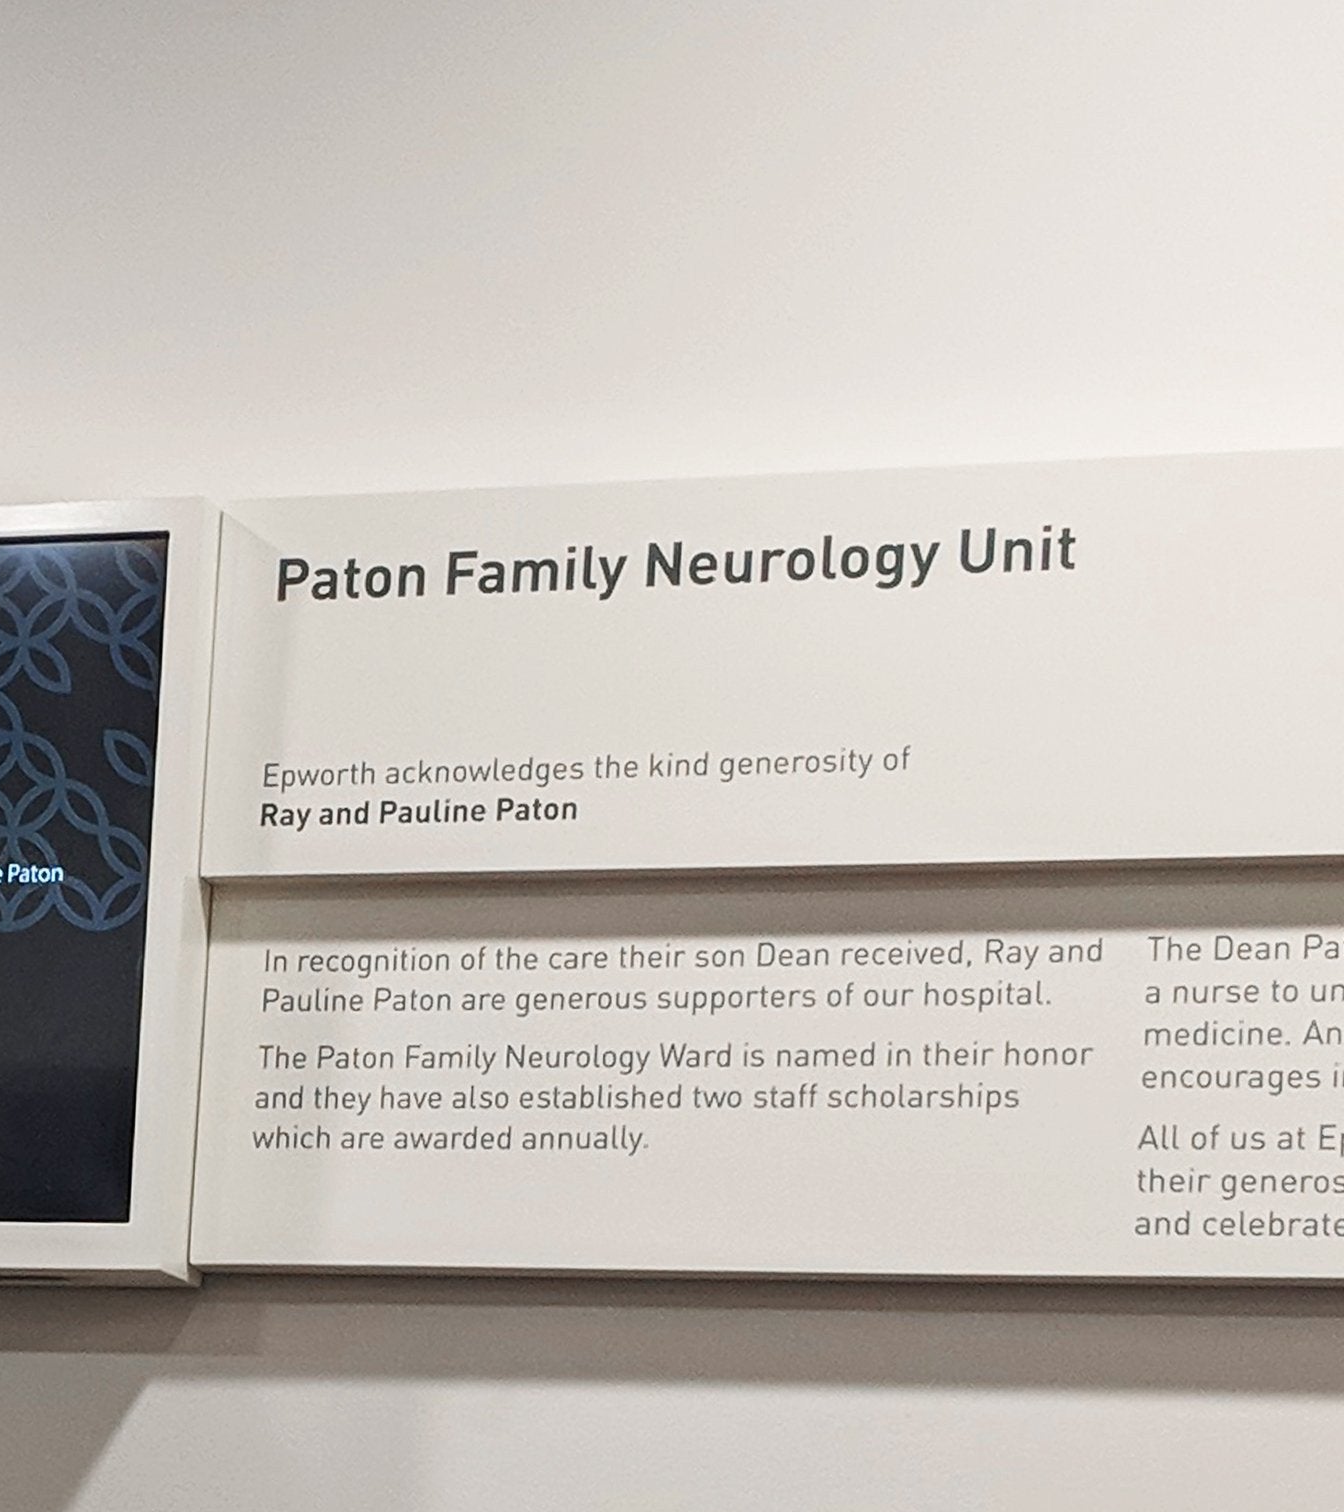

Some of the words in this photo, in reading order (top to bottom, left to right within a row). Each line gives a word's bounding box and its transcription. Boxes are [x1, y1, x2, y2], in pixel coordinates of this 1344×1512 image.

[277, 557, 426, 603] Paton
[446, 544, 628, 601] Family
[645, 534, 941, 590] Neurology
[960, 524, 1077, 574] Unit
[262, 760, 376, 795] Epworth
[385, 756, 585, 788] acknowledges
[594, 753, 639, 780] the
[649, 750, 710, 778] kind
[719, 747, 874, 783] generosity
[883, 744, 912, 772] of
[259, 802, 313, 833] Ray
[318, 800, 370, 826] and
[379, 798, 487, 825] Pauline
[496, 797, 578, 822] Paton
[7, 863, 64, 884] Paton
[264, 949, 288, 973] In
[297, 947, 450, 979] recognition
[460, 946, 486, 971] of
[495, 946, 539, 971] the
[548, 951, 608, 971] care
[619, 945, 686, 969] their
[694, 949, 745, 969] son
[756, 942, 830, 968] Dean
[841, 940, 972, 968] received,
[984, 938, 1040, 971] Ray
[1048, 937, 1103, 964] and
[1147, 936, 1202, 962] The
[1214, 935, 1290, 961] Dean
[262, 986, 364, 1013] Pauline
[373, 986, 452, 1012] Paton
[460, 992, 506, 1011] are
[515, 990, 648, 1018] generous
[657, 985, 817, 1016] supporters
[826, 981, 855, 1008] of
[863, 988, 915, 1008] our
[923, 979, 1052, 1013] hospital.
[1145, 985, 1161, 1005] a
[1172, 984, 1260, 1005] nurse
[1271, 979, 1299, 1003] to
[1144, 1019, 1291, 1047] medicine.
[258, 1044, 308, 1070] The
[316, 1044, 394, 1070] Paton
[405, 1043, 497, 1076] Family
[505, 1043, 651, 1076] Neurology
[659, 1042, 732, 1069] Ward
[743, 1041, 765, 1068] is
[776, 1041, 876, 1068] named
[887, 1041, 912, 1067] in
[923, 1040, 995, 1067] their
[1004, 1040, 1094, 1067] honor
[1141, 1069, 1322, 1097] encourages
[254, 1084, 304, 1110] and
[314, 1085, 372, 1117] they
[380, 1084, 443, 1110] have
[452, 1084, 510, 1110] also
[519, 1083, 683, 1110] established
[692, 1085, 743, 1109] two
[753, 1082, 819, 1110] staff
[827, 1081, 1020, 1116] scholarships
[252, 1124, 331, 1150] which
[340, 1131, 385, 1150] are
[393, 1125, 513, 1151] awarded
[521, 1124, 649, 1157] annually.
[1137, 1124, 1180, 1151] All
[1190, 1123, 1221, 1151] of
[1230, 1131, 1266, 1151] us
[1276, 1126, 1306, 1151] at
[1137, 1167, 1212, 1194] their
[1134, 1209, 1191, 1236] and
